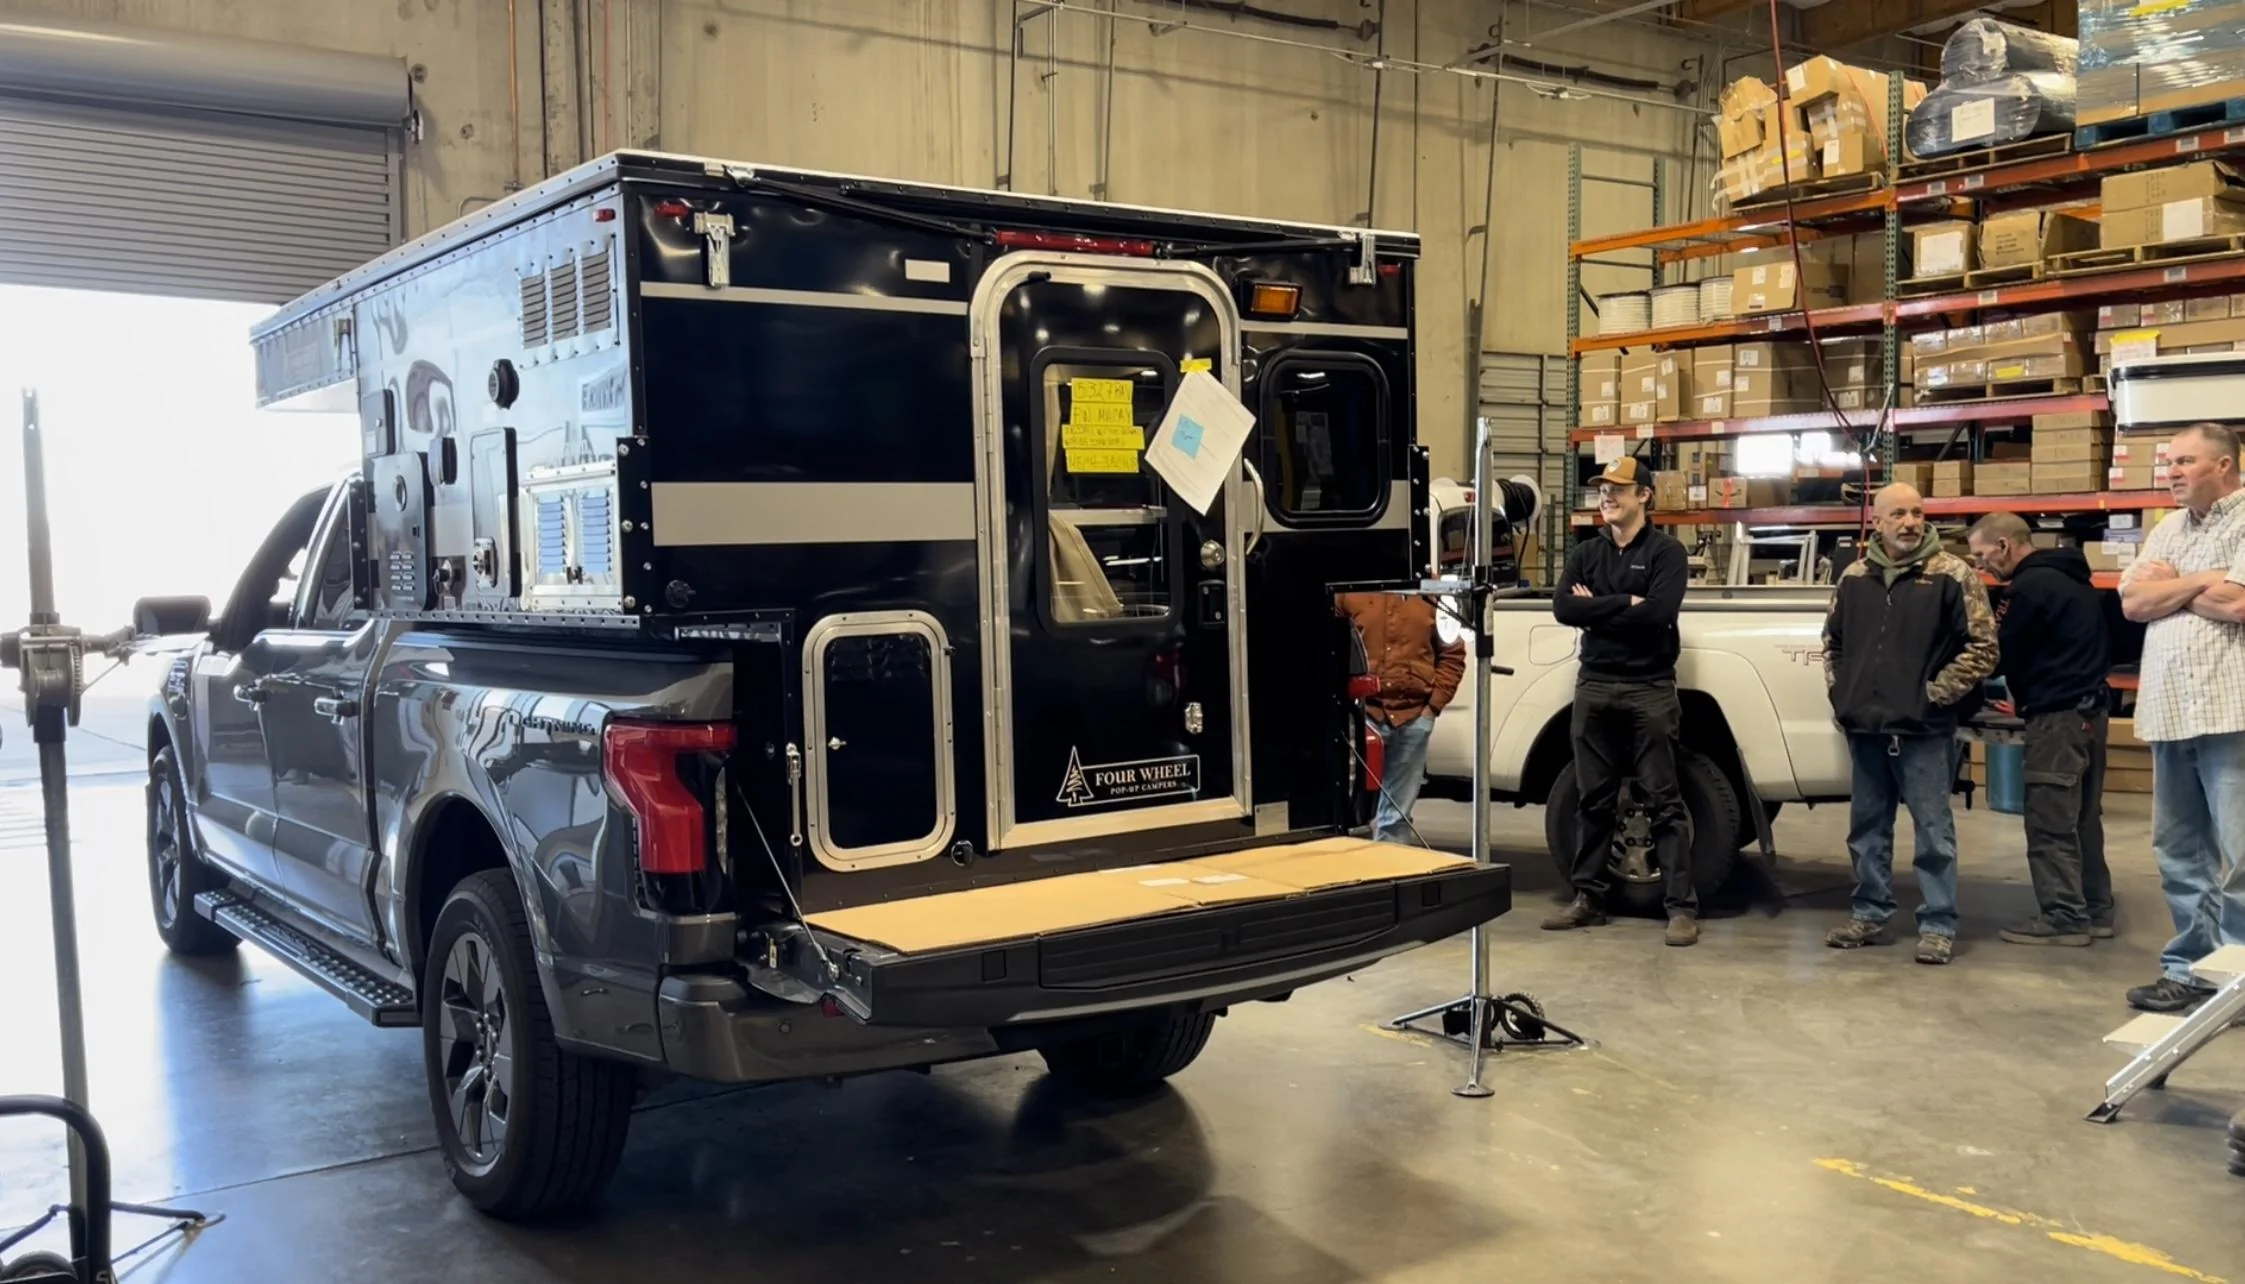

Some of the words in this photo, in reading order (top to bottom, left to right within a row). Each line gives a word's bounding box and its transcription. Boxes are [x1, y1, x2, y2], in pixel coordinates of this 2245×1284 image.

[1095, 770, 1136, 787] FOUR
[1140, 763, 1191, 781] WHEEL
[1110, 785, 1140, 795] POP-UP
[1141, 780, 1177, 792] CAMPERS
